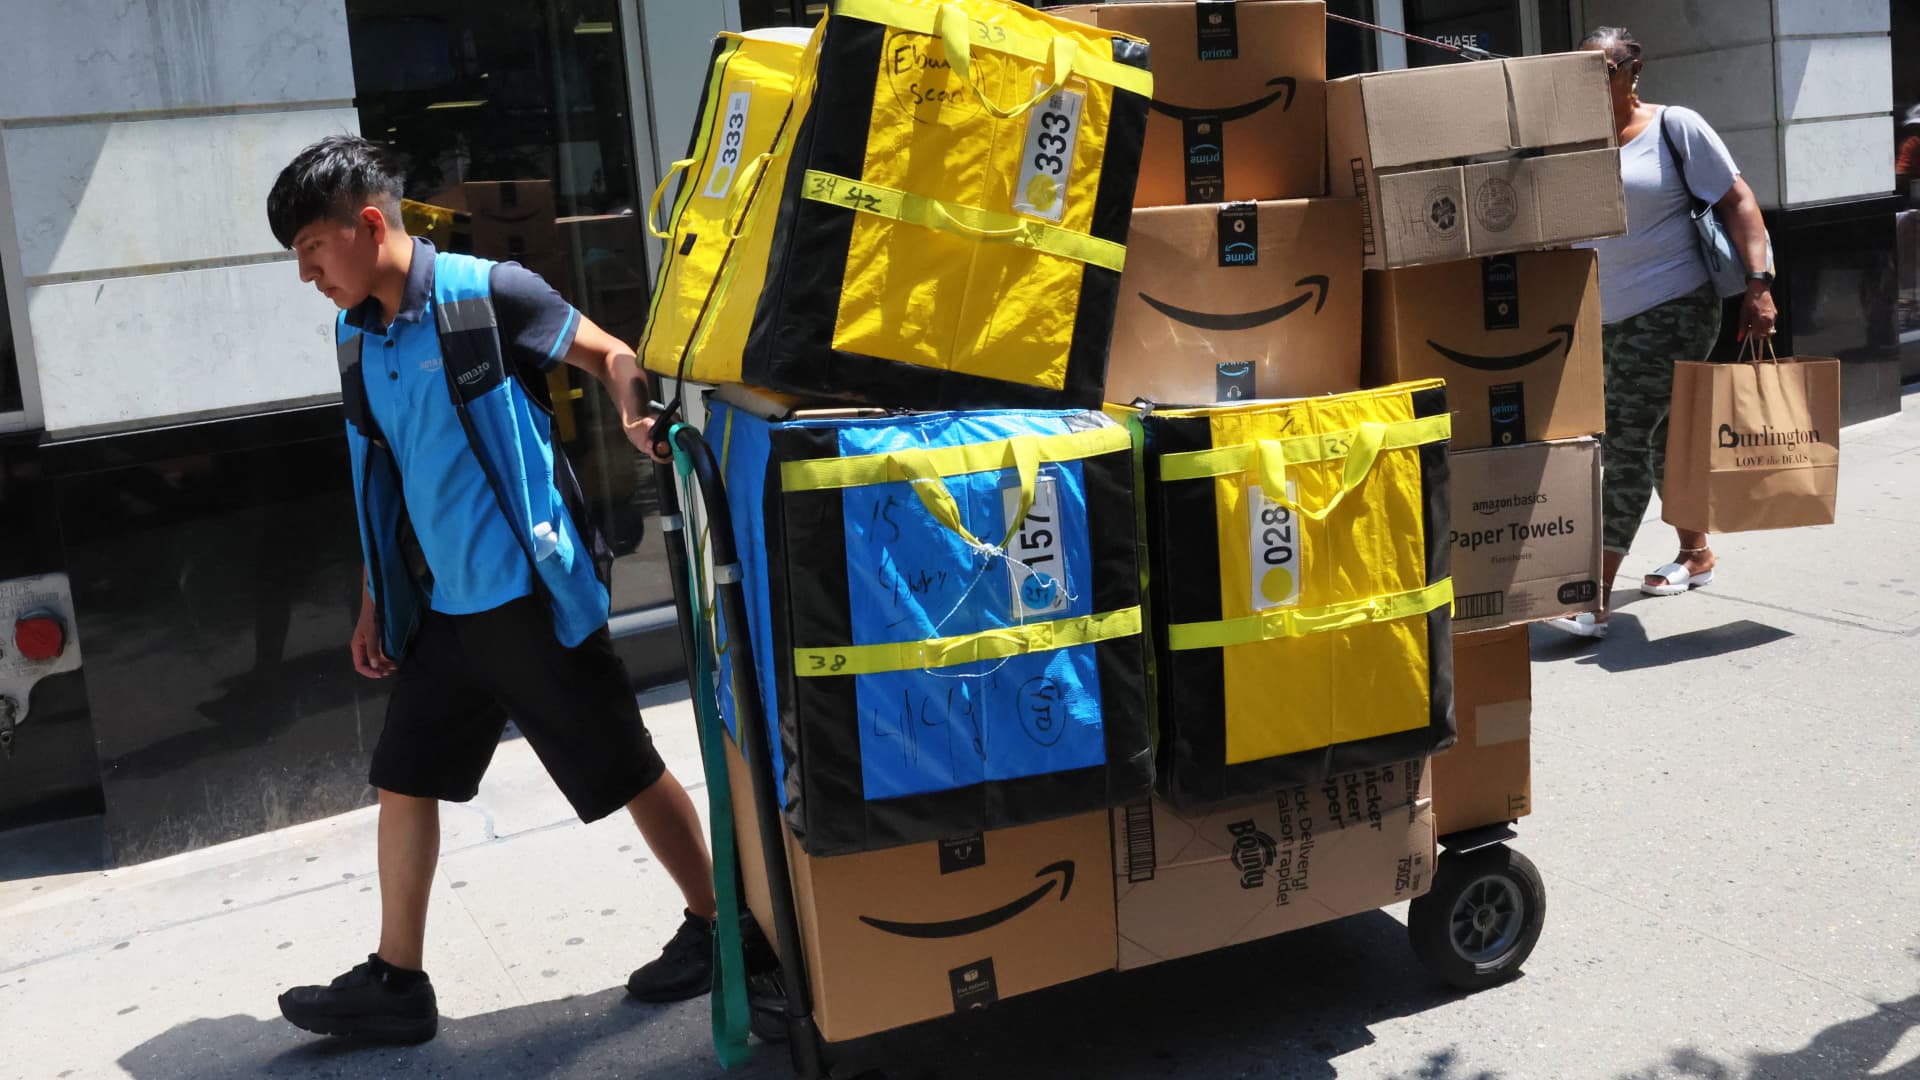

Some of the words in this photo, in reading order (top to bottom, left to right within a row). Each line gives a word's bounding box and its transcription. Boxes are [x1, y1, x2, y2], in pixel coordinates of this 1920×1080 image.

[1201, 47, 1233, 62] prime
[1435, 34, 1478, 47] CHASE
[722, 113, 744, 164] 333
[1034, 111, 1071, 175] 333
[1189, 151, 1220, 165] prime
[1225, 250, 1256, 264] prime
[457, 361, 490, 385] amazo
[1719, 424, 1820, 451] Burlington
[1736, 456, 1763, 467] LOVE
[1767, 457, 1779, 465] the
[1782, 454, 1809, 465] DEALS
[1020, 514, 1054, 568] 157
[1261, 505, 1293, 565] 028
[1449, 526, 1504, 552] Paper
[1507, 516, 1574, 541] Towels
[809, 655, 846, 672] 38
[1294, 786, 1311, 815] ick
[1344, 773, 1361, 823] cker
[1276, 789, 1295, 849] raison
[1227, 818, 1265, 890] Bounty
[1291, 816, 1315, 891] Delivery!
[1275, 850, 1292, 907] rapide!
